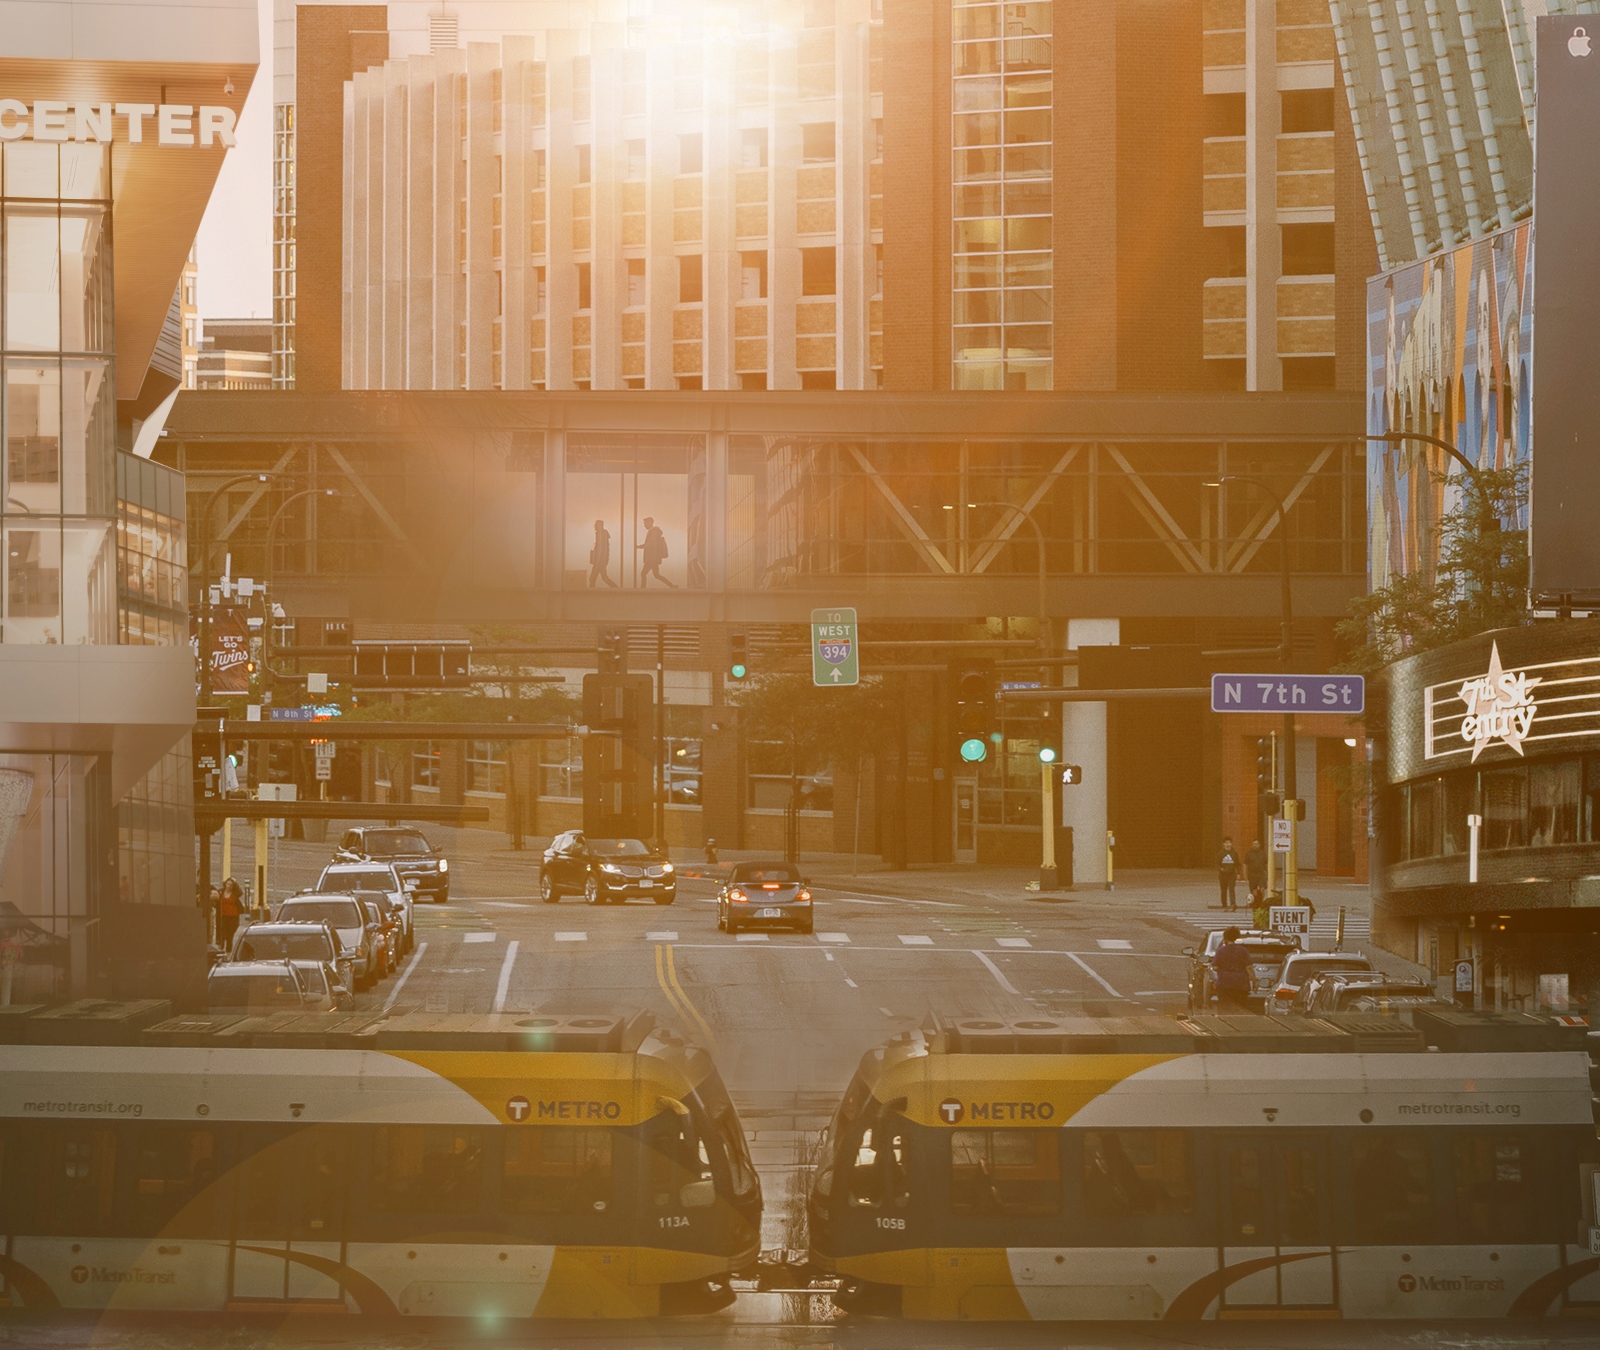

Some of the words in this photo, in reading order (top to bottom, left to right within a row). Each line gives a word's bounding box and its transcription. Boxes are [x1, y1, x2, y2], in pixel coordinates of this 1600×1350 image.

[826, 612, 842, 623] TO
[818, 625, 851, 637] WEST
[211, 649, 249, 668] Twins
[823, 646, 848, 660] 394
[1223, 682, 1242, 704] N
[1256, 682, 1308, 705] 7th
[1320, 683, 1352, 705] St
[1457, 677, 1497, 715] 7th
[1498, 672, 1536, 708] St
[272, 709, 279, 718] N
[284, 709, 299, 718] 8th
[303, 709, 313, 718] St
[1460, 701, 1539, 741] entry
[1278, 822, 1287, 831] NO
[1273, 911, 1305, 924] EVENT
[1277, 925, 1301, 933] RATE
[22, 1099, 143, 1118] metrotransit.org
[537, 1101, 621, 1119] METRO
[970, 1102, 1055, 1121] METRO
[1396, 1100, 1521, 1119] metrotransit.org
[658, 1216, 690, 1229] 113A
[875, 1217, 906, 1231] 105B
